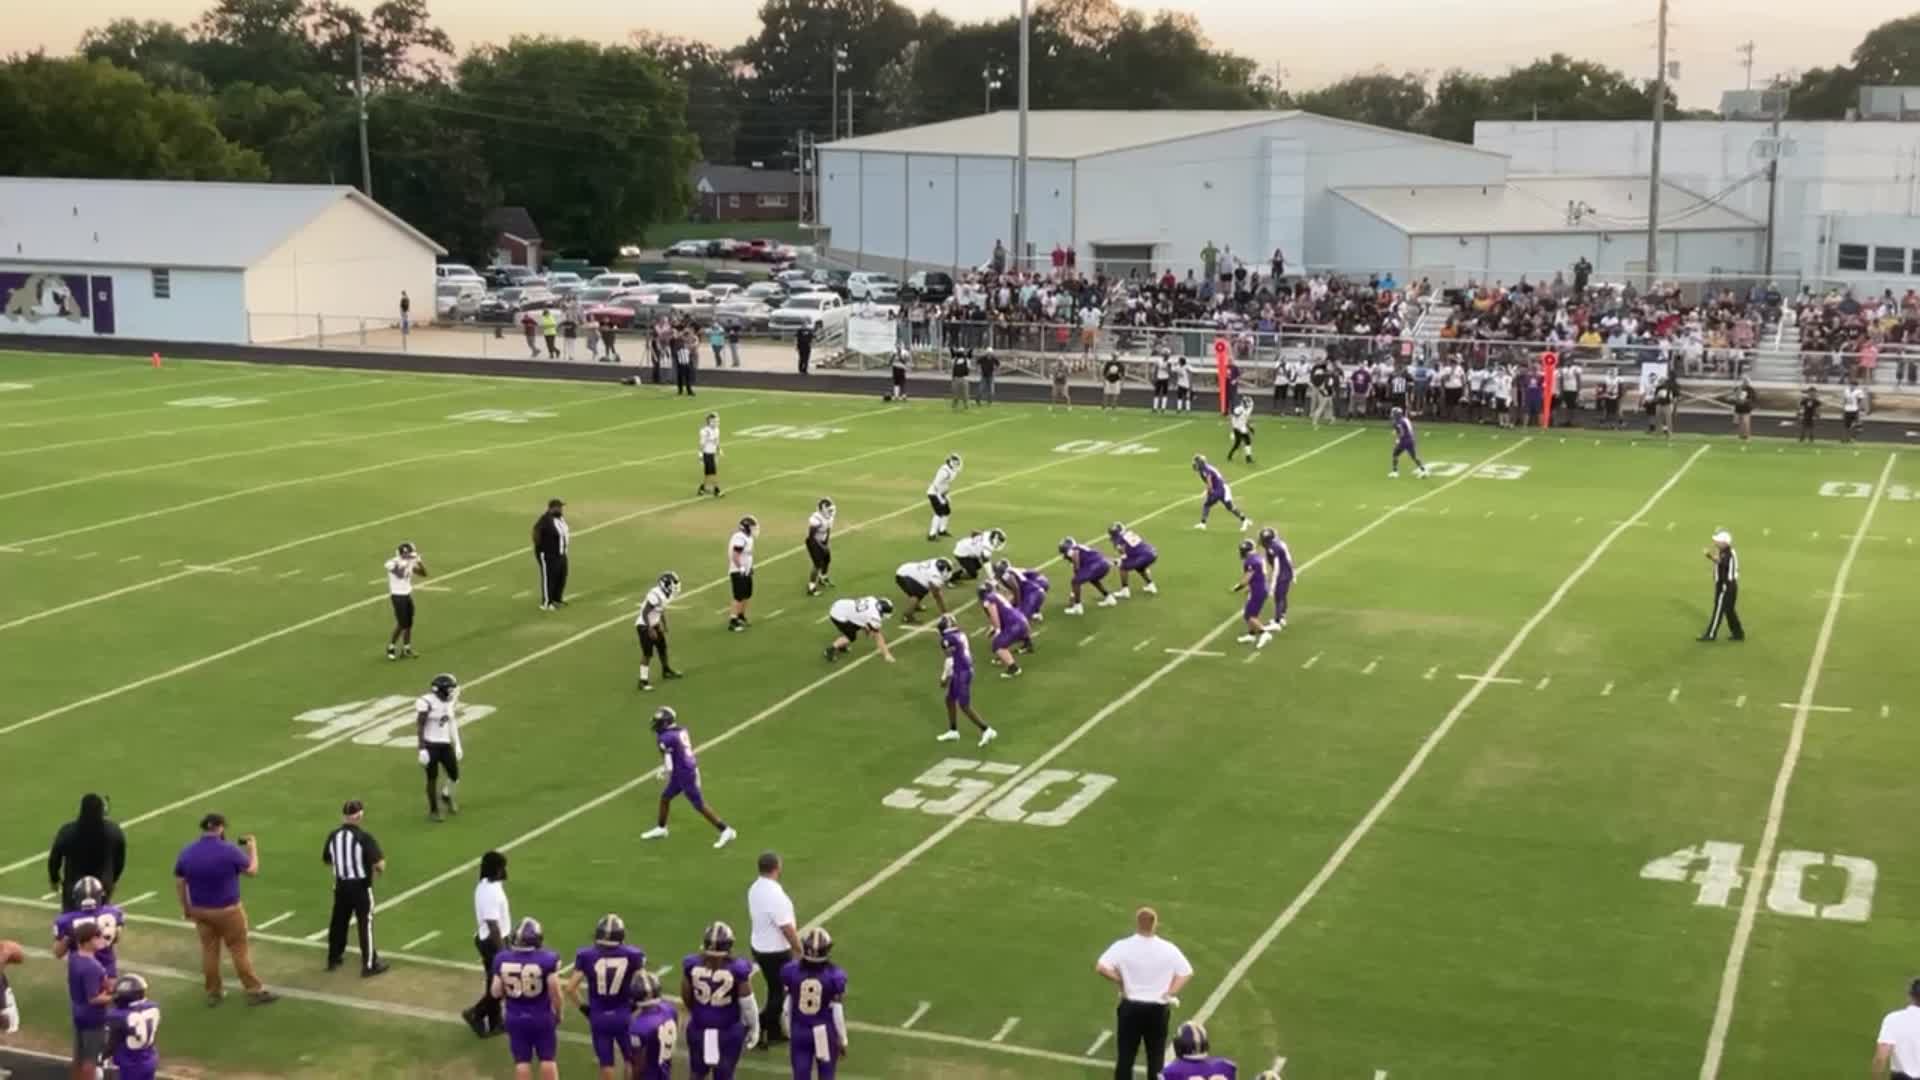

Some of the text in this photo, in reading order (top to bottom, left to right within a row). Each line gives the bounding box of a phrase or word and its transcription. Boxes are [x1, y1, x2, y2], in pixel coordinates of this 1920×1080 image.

[881, 758, 1118, 826] 50
[1640, 840, 1878, 922] 40
[594, 957, 629, 995] 17
[691, 966, 734, 1007] 52
[799, 978, 823, 1015] 8
[126, 1007, 160, 1050] 37
